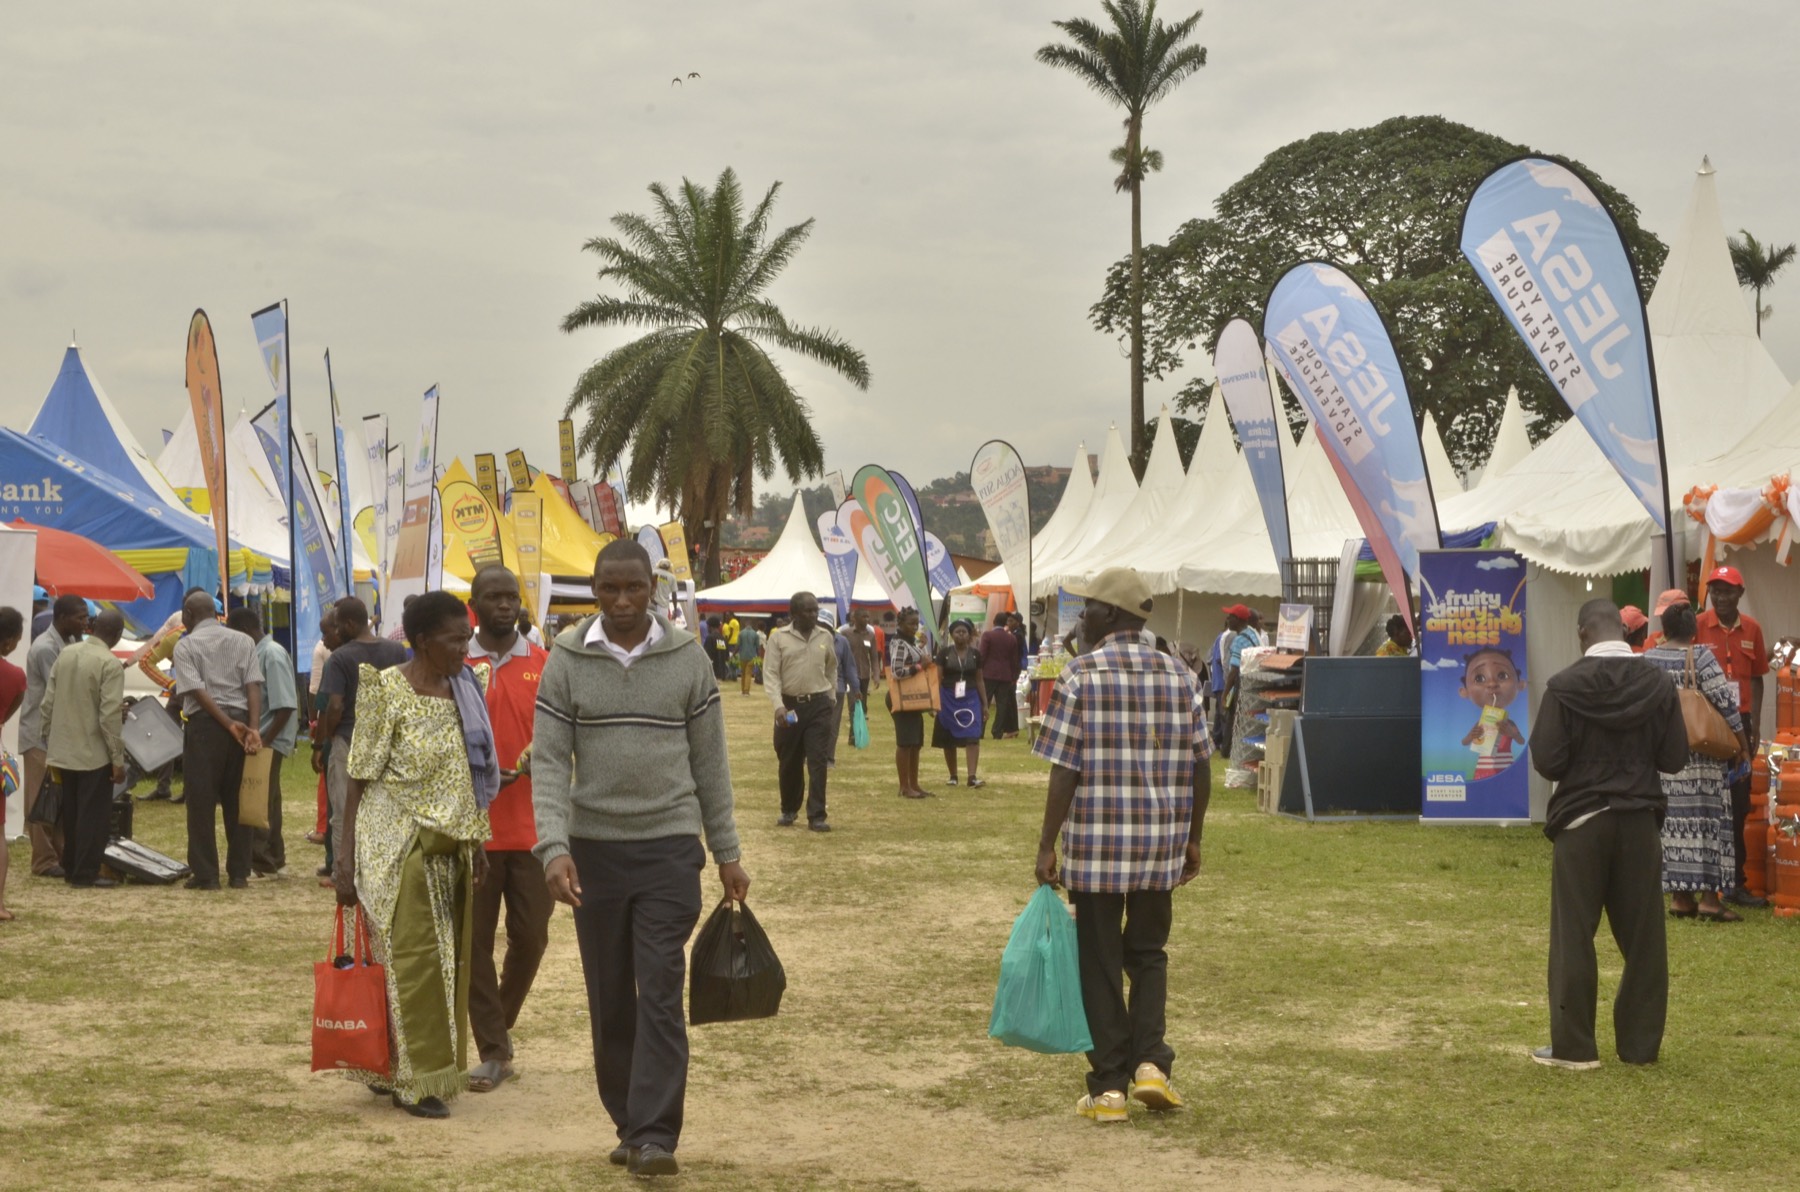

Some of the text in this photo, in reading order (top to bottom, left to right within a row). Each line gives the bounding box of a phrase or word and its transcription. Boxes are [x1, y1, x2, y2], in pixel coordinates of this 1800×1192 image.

[0, 477, 63, 503] ank
[34, 506, 64, 515] YOU
[1445, 588, 1502, 610] fruity
[1432, 603, 1489, 624] dairy
[1426, 613, 1522, 635] amazing
[1447, 630, 1501, 646] ness
[1427, 774, 1465, 783] JESA
[316, 1017, 367, 1030] LIGABA
